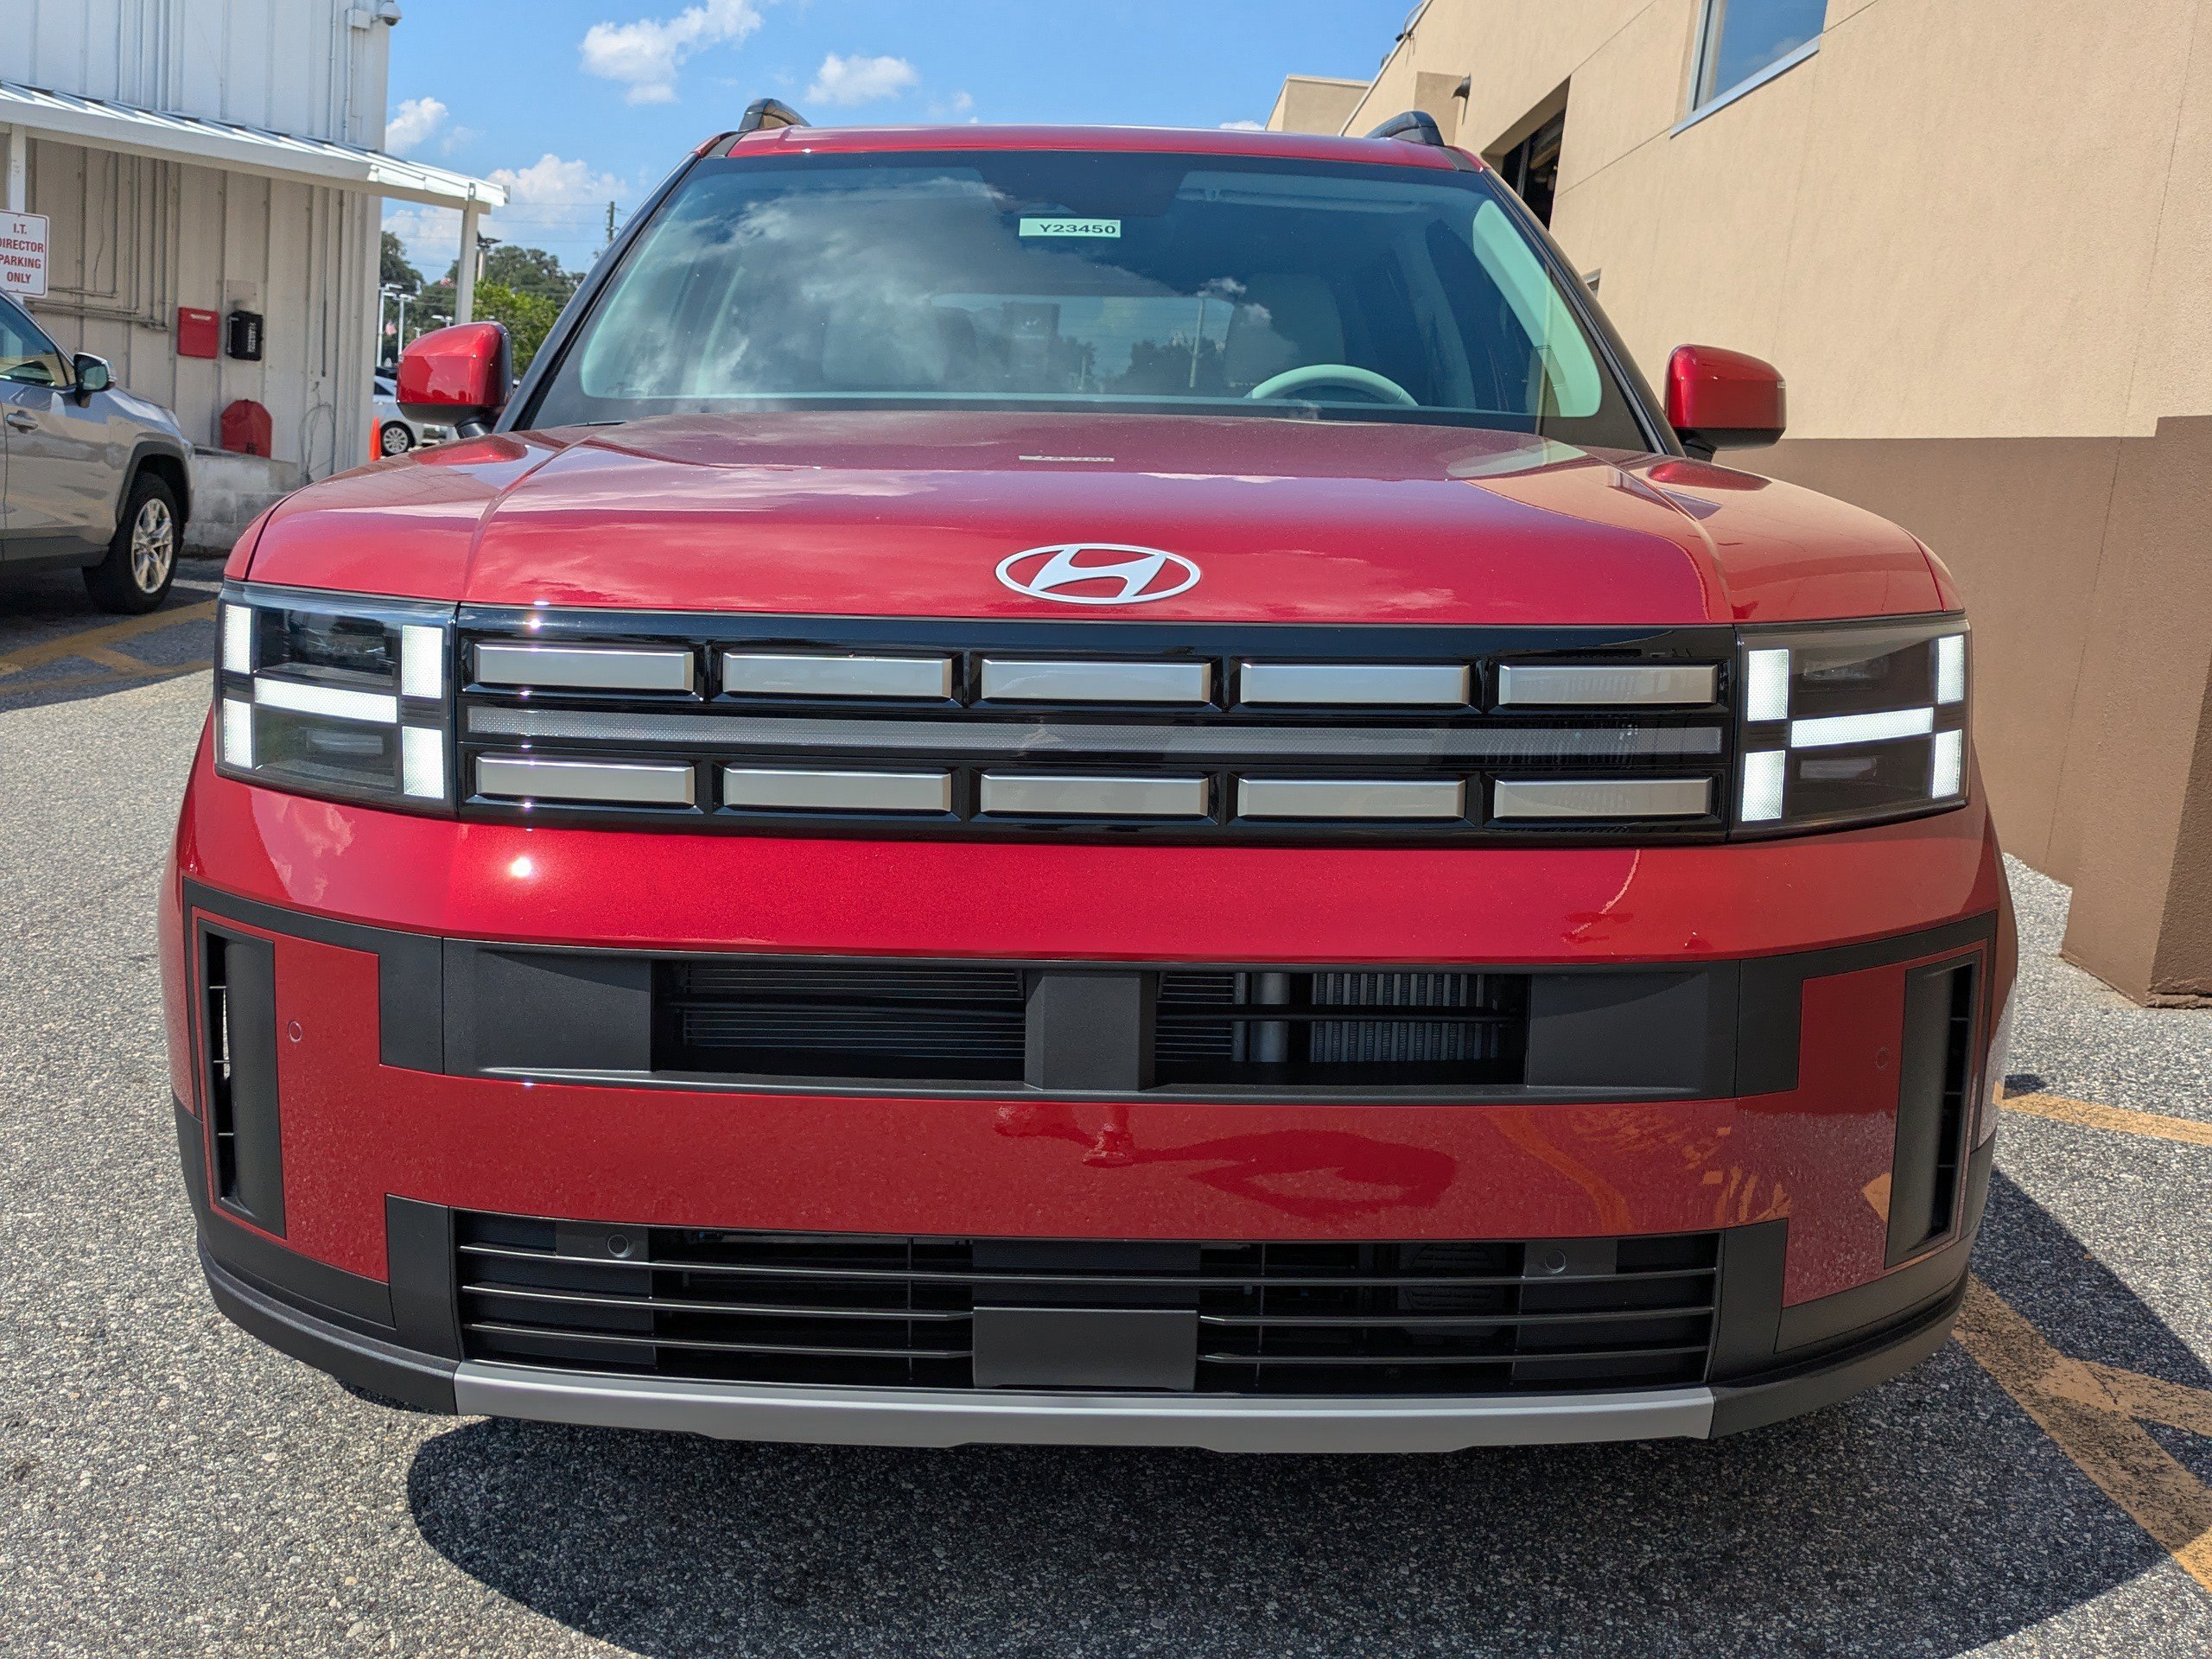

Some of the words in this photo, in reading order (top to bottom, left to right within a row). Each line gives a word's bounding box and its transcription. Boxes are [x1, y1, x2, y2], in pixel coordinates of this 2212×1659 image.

[13, 223, 27, 235] I.T.
[1039, 224, 1116, 234] Y23450
[0, 254, 41, 269] PARKING
[7, 271, 31, 283] ONLY
